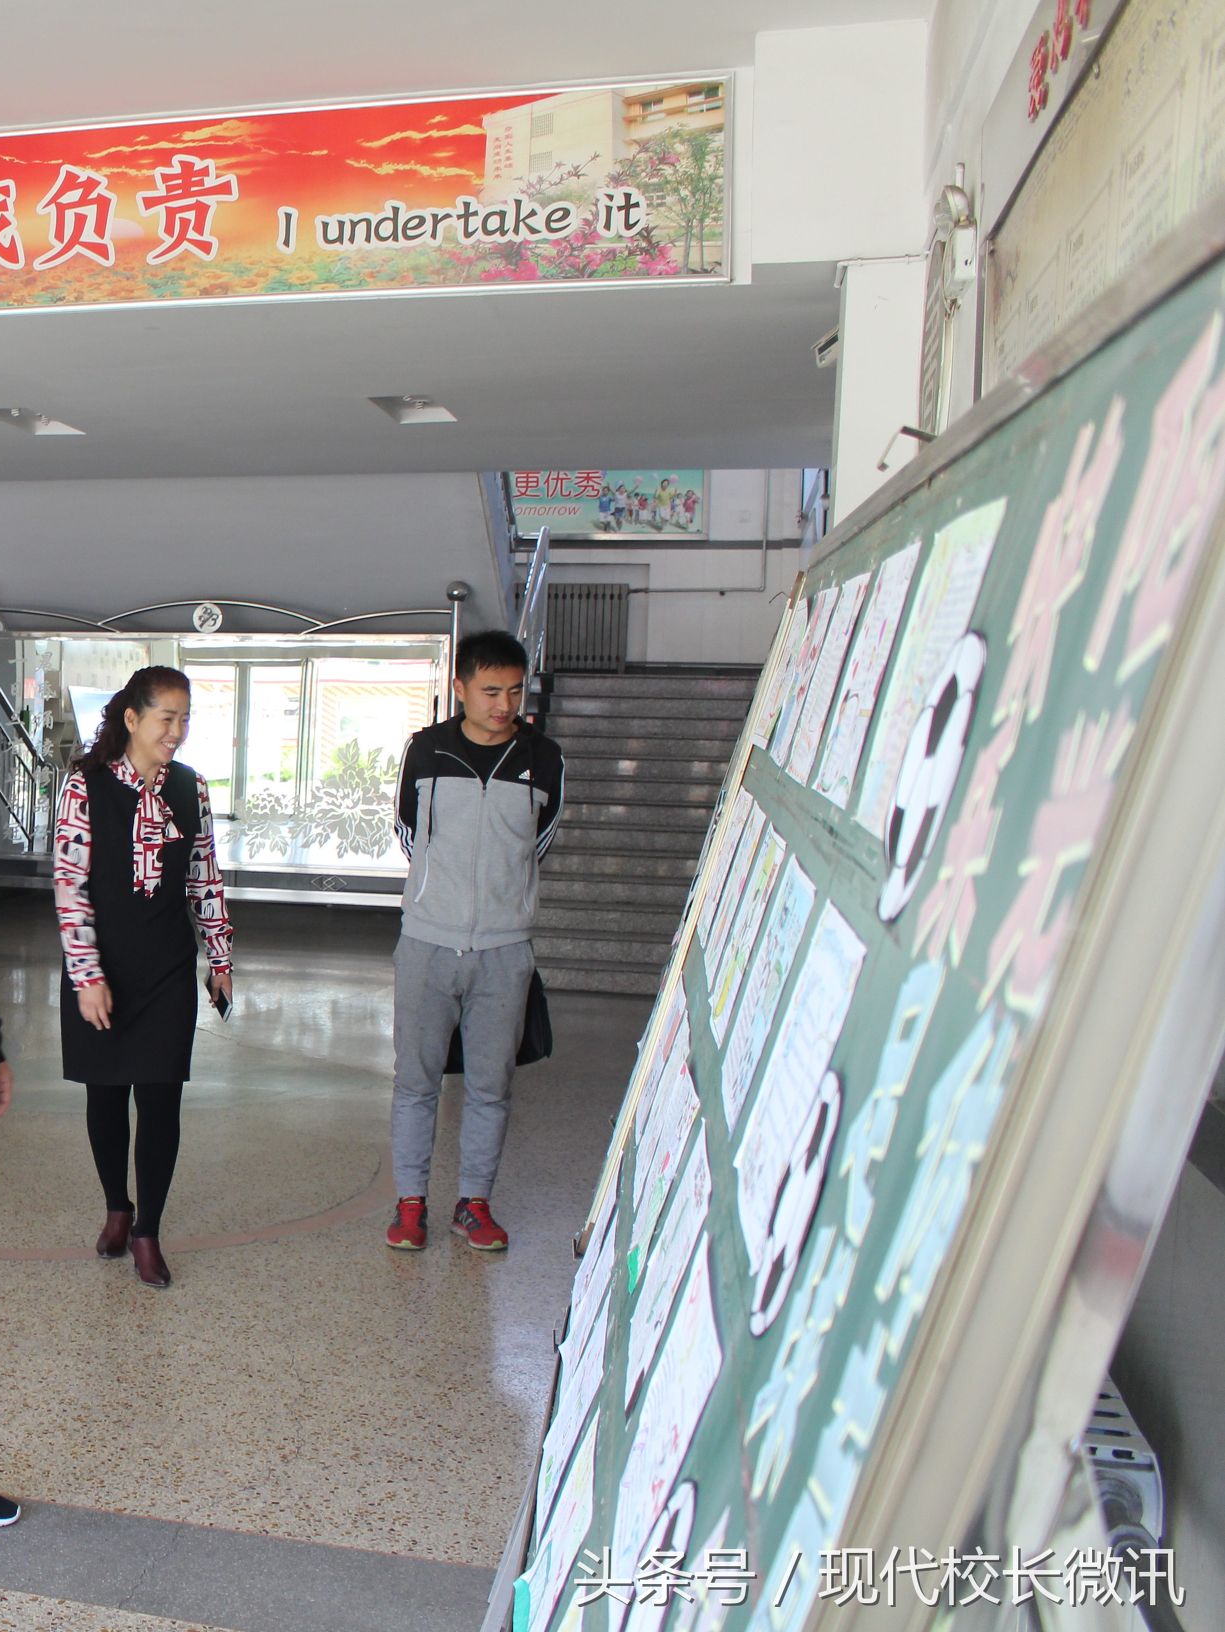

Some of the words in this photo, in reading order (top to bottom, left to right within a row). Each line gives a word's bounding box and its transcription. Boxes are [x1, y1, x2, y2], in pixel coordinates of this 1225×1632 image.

[320, 198, 573, 246] undertake
[604, 191, 641, 233] it
[513, 470, 603, 498] 更优秀
[513, 505, 580, 516] omorrow
